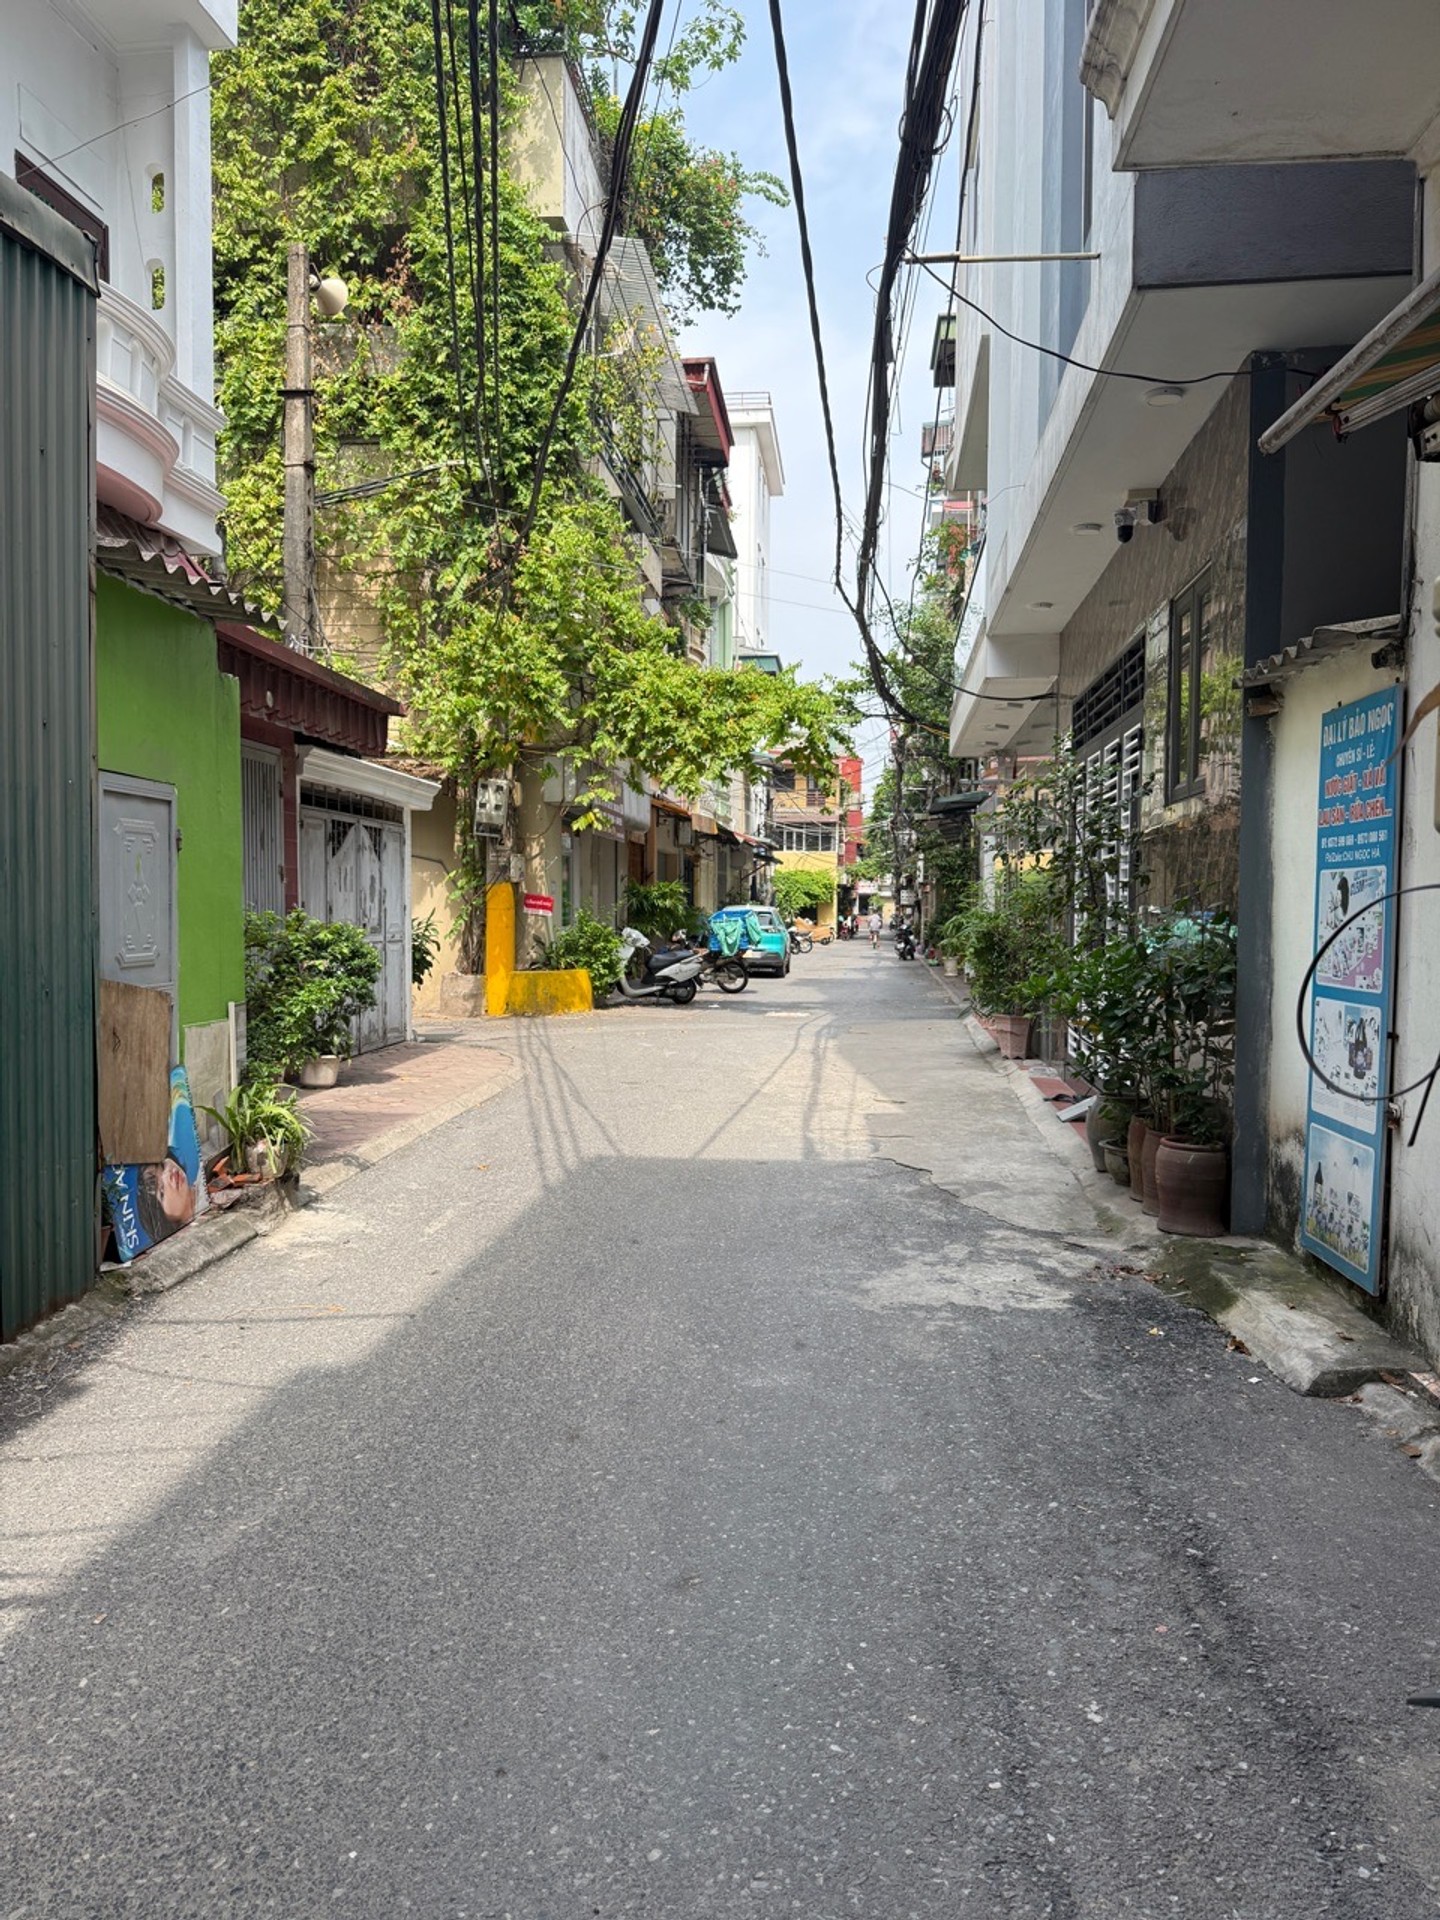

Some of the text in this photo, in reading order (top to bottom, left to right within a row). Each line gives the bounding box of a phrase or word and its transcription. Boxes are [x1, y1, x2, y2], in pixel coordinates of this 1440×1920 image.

[1337, 714, 1348, 743] LÝ
[1348, 707, 1366, 739] BẢO
[1367, 702, 1394, 733] NGỌC
[120, 1194, 139, 1249] SKIN
